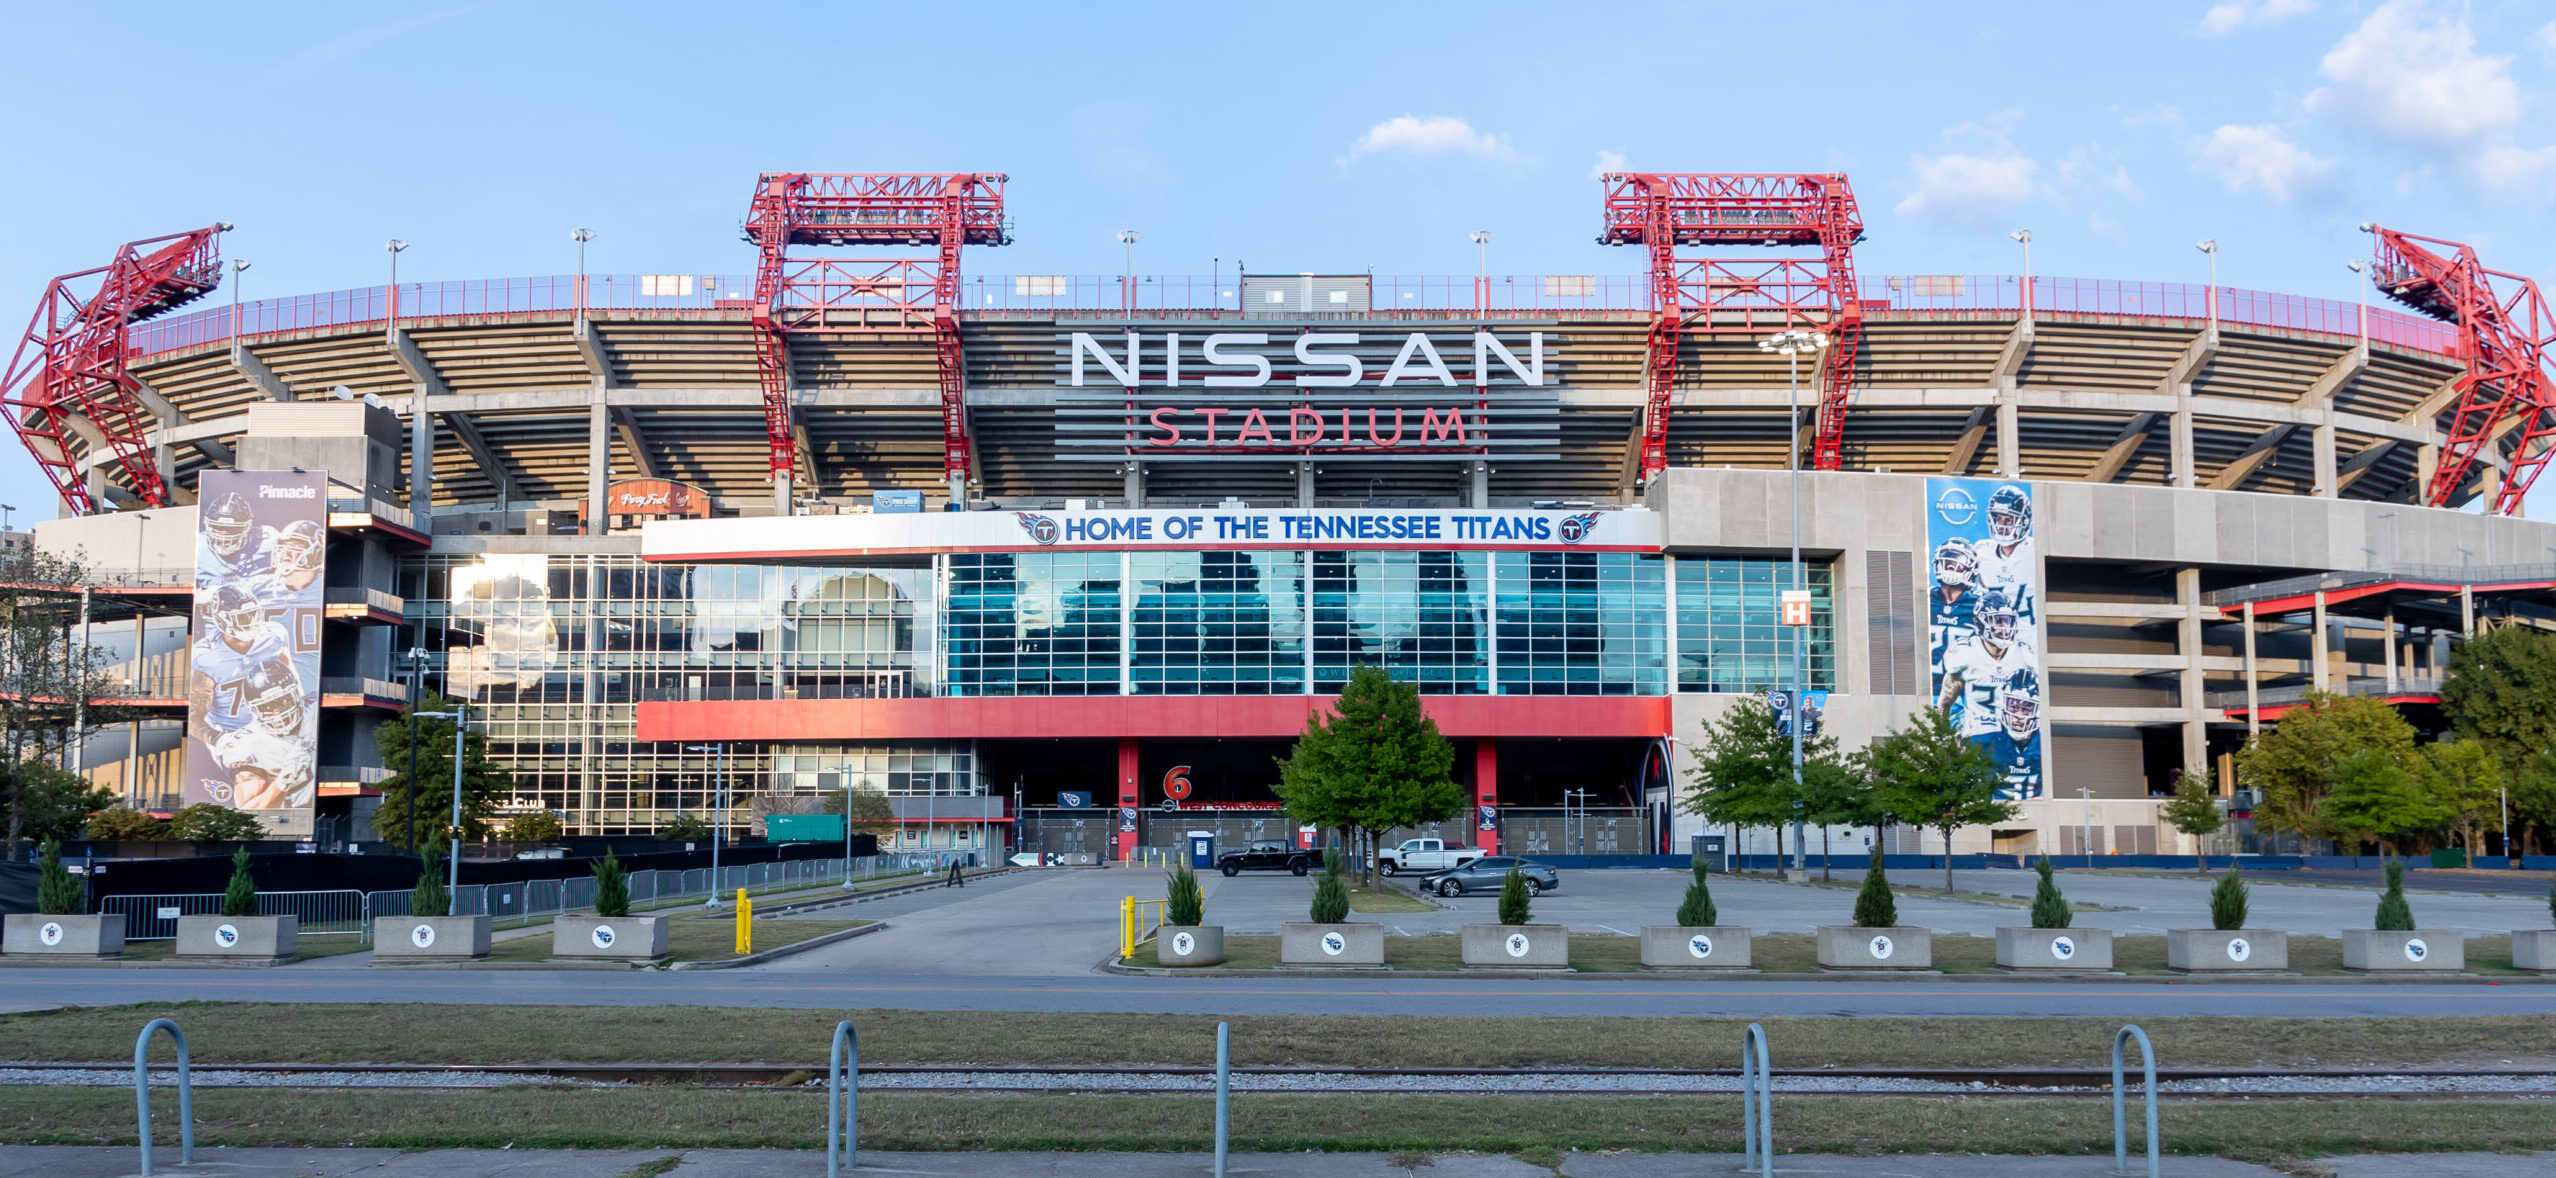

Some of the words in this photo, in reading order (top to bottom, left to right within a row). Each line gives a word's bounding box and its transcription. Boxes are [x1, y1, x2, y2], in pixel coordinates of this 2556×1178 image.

[1071, 332, 1544, 388] NISSAN
[1149, 407, 1467, 446] STADIUM
[259, 485, 316, 499] Pinnacle
[1936, 502, 1978, 510] NISSAN
[1066, 518, 1152, 540] HOME
[1163, 517, 1203, 540] OF
[1217, 517, 1269, 539] THE
[1280, 516, 1442, 540] TENNESSEE
[1452, 517, 1551, 540] TITANS
[1786, 602, 1807, 623] H
[1163, 765, 1192, 801] 6
[1178, 801, 1208, 809] WEST
[1212, 801, 1282, 810] CONCOURSE
